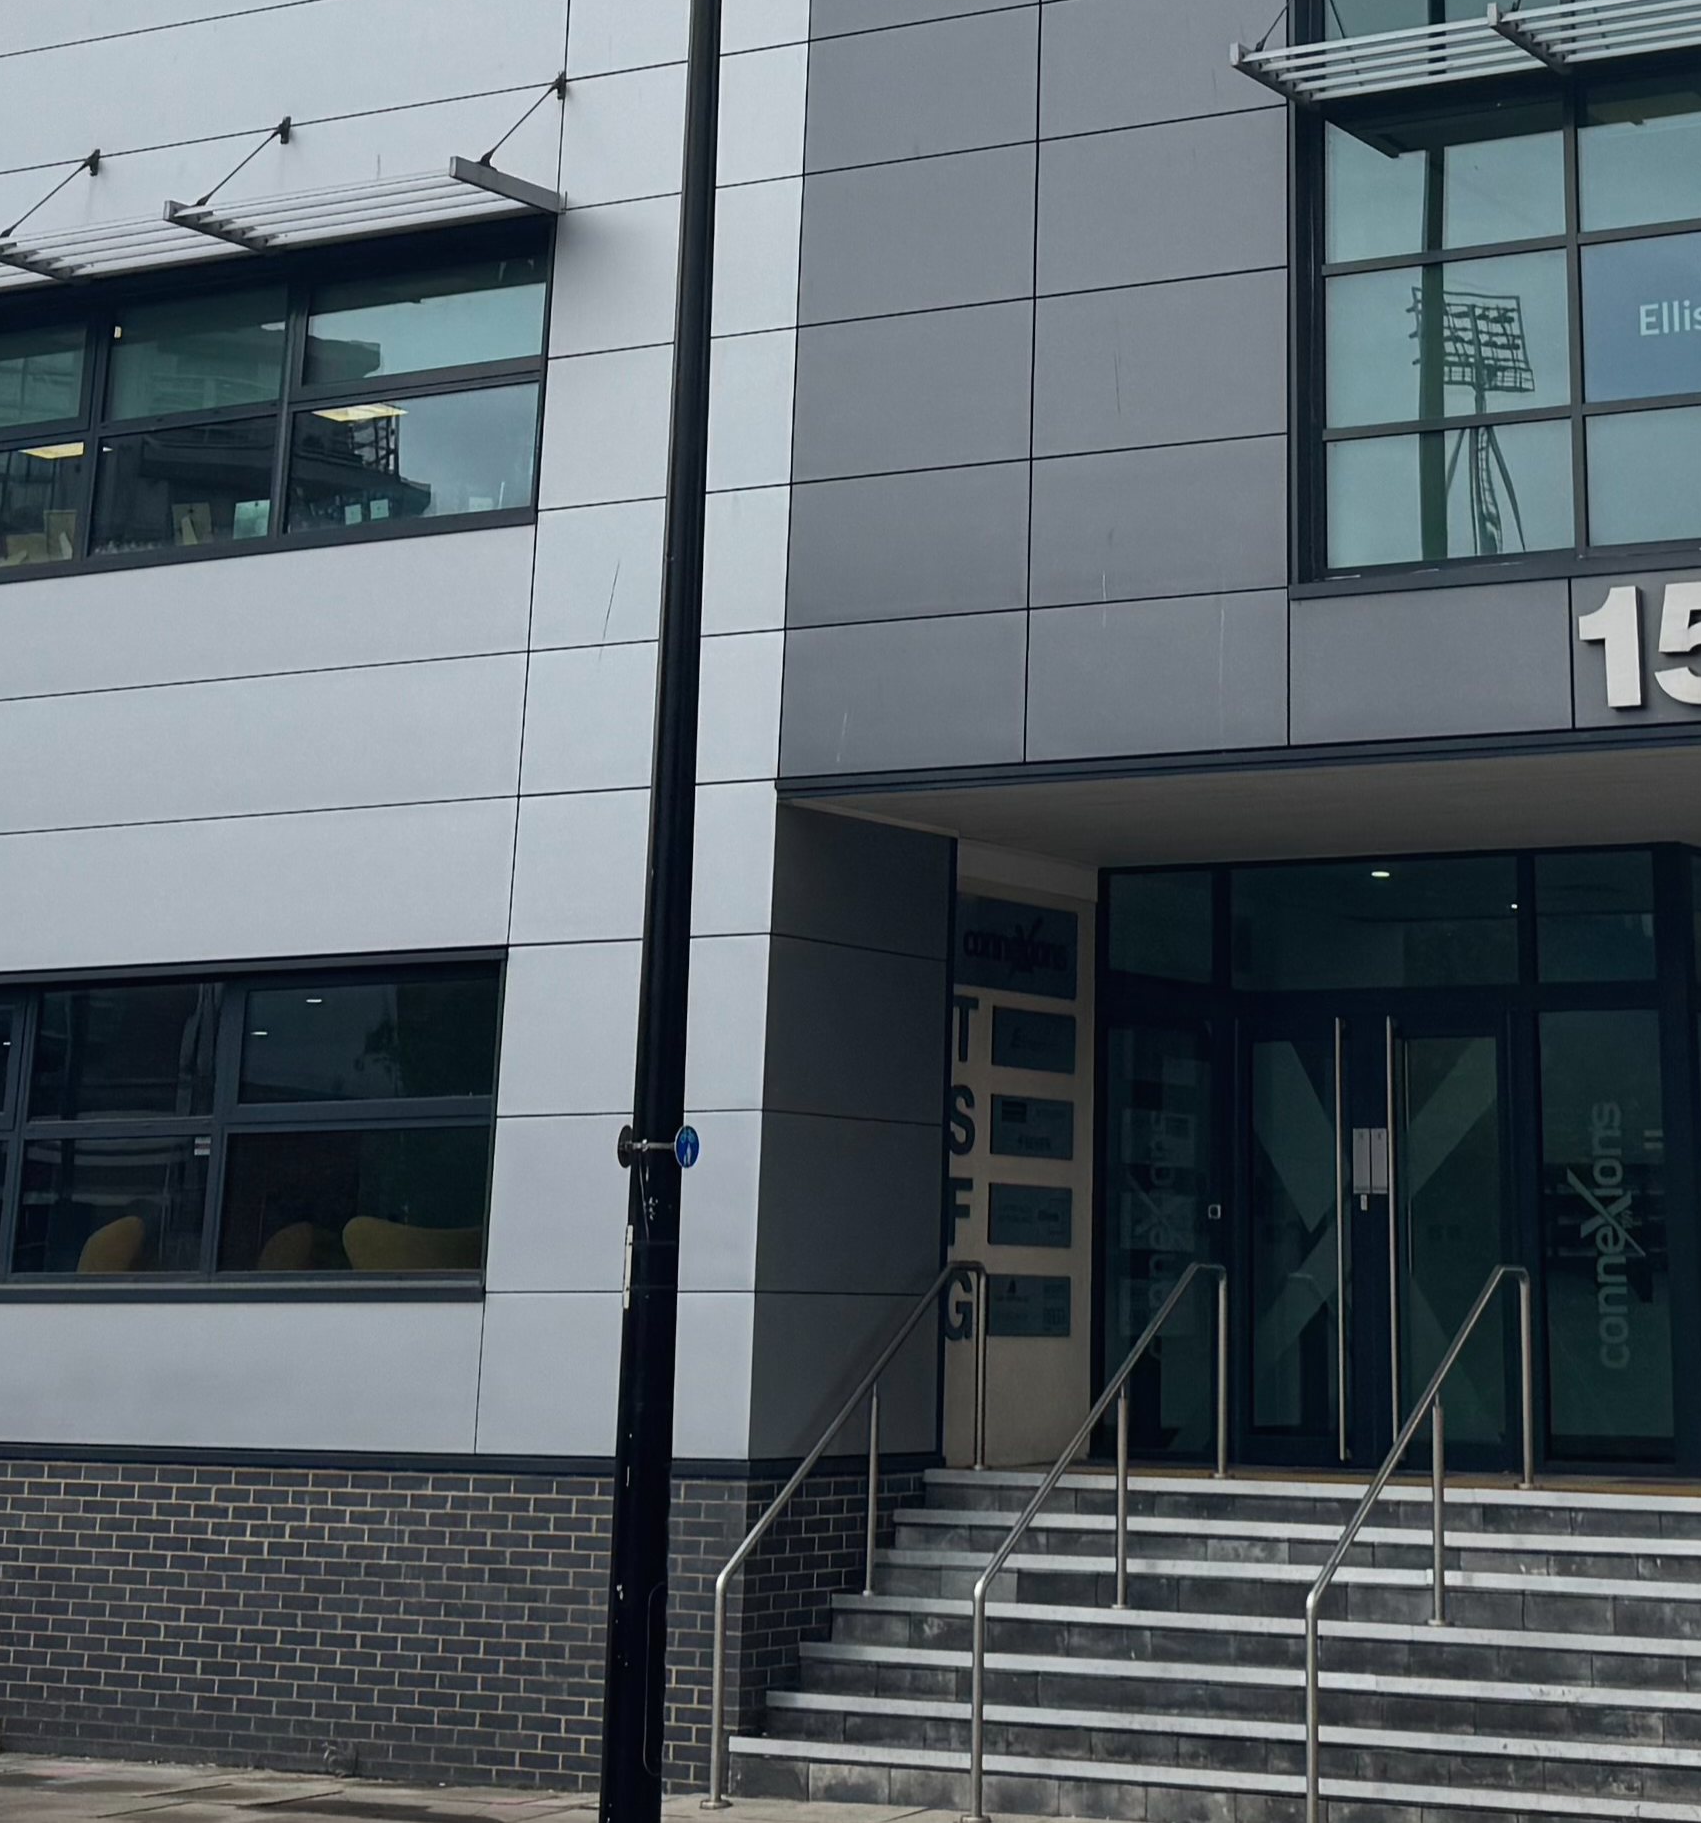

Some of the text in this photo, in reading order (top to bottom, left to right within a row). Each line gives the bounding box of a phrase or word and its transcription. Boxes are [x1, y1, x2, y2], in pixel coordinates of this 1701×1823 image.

[953, 995, 979, 1062] T
[948, 1084, 976, 1156] S
[947, 1177, 974, 1246] F
